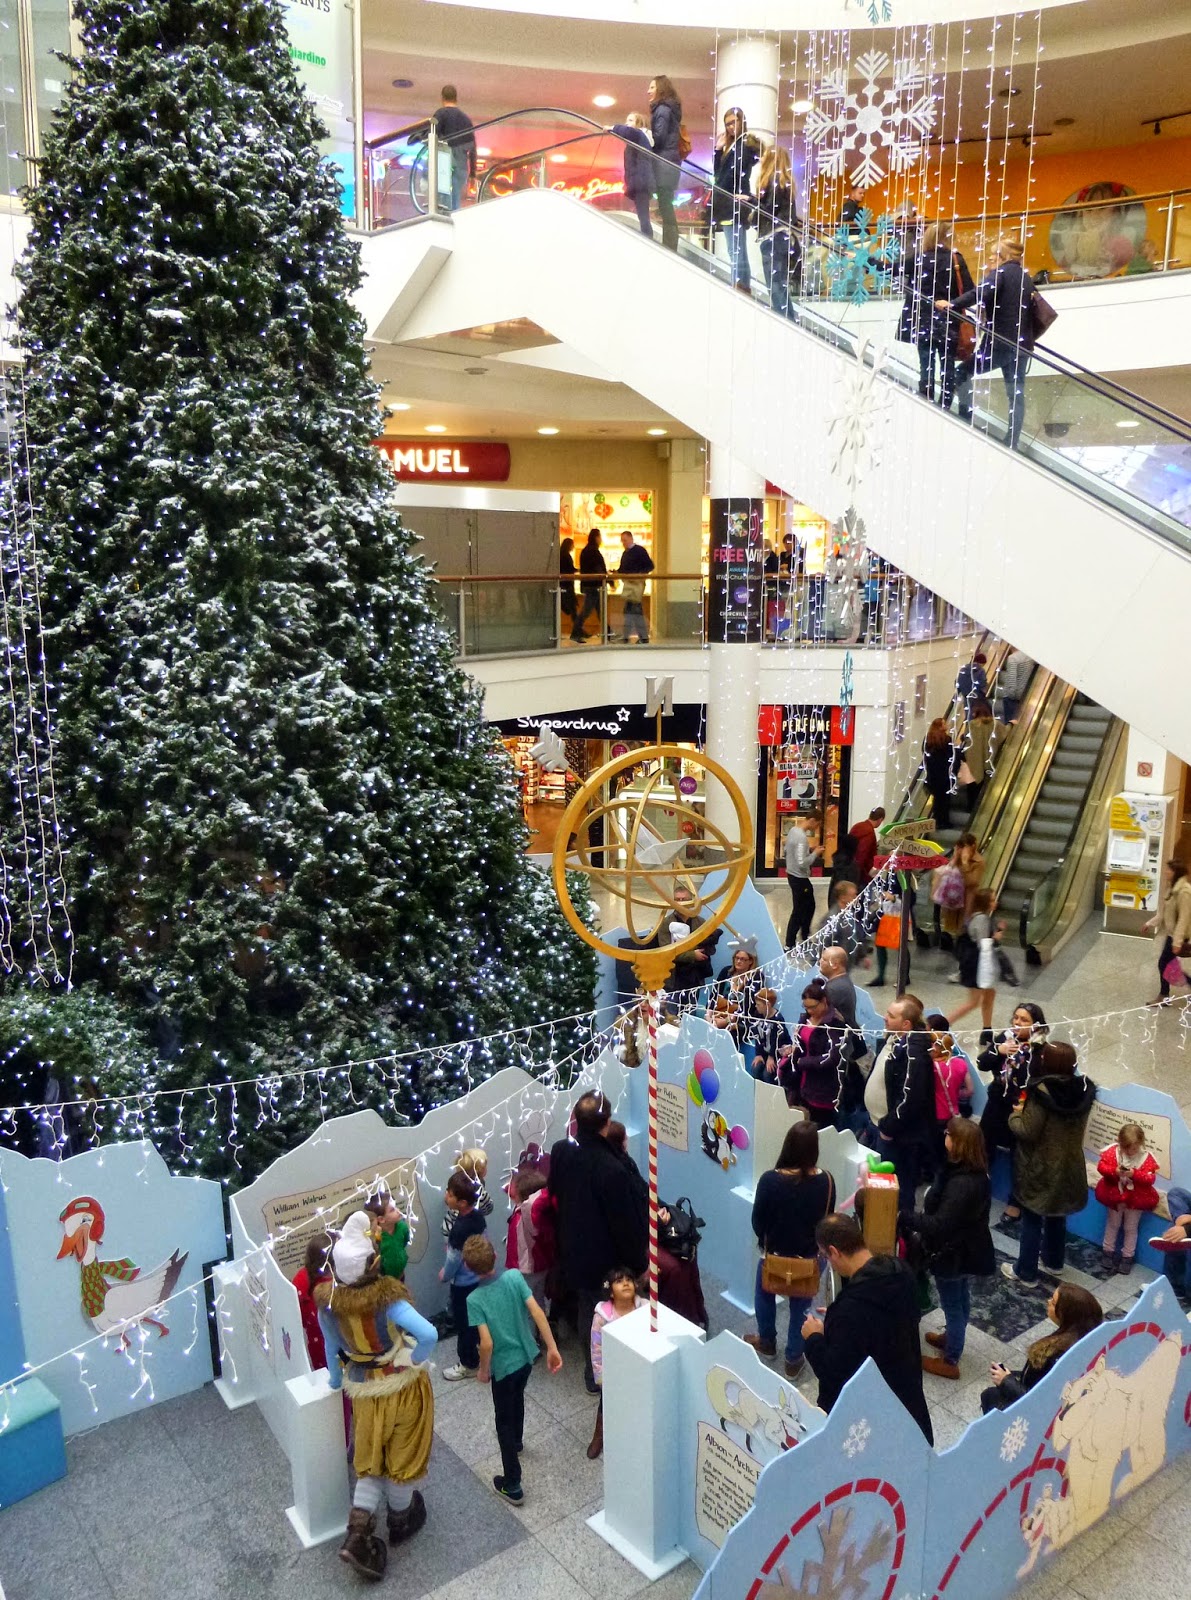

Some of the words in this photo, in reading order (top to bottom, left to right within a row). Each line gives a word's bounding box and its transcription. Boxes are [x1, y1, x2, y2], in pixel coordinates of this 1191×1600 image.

[713, 548, 744, 563] FREE
[517, 716, 621, 735] Superdrug
[782, 717, 830, 732] PERFUME
[895, 826, 915, 837] NORTH
[918, 823, 933, 833] POLE
[883, 836, 904, 849] CASH
[908, 844, 930, 856] ONLY
[272, 1202, 300, 1216] William
[302, 1194, 327, 1207] Walrus
[705, 1433, 728, 1457] Albion
[733, 1454, 755, 1477] Arctic
